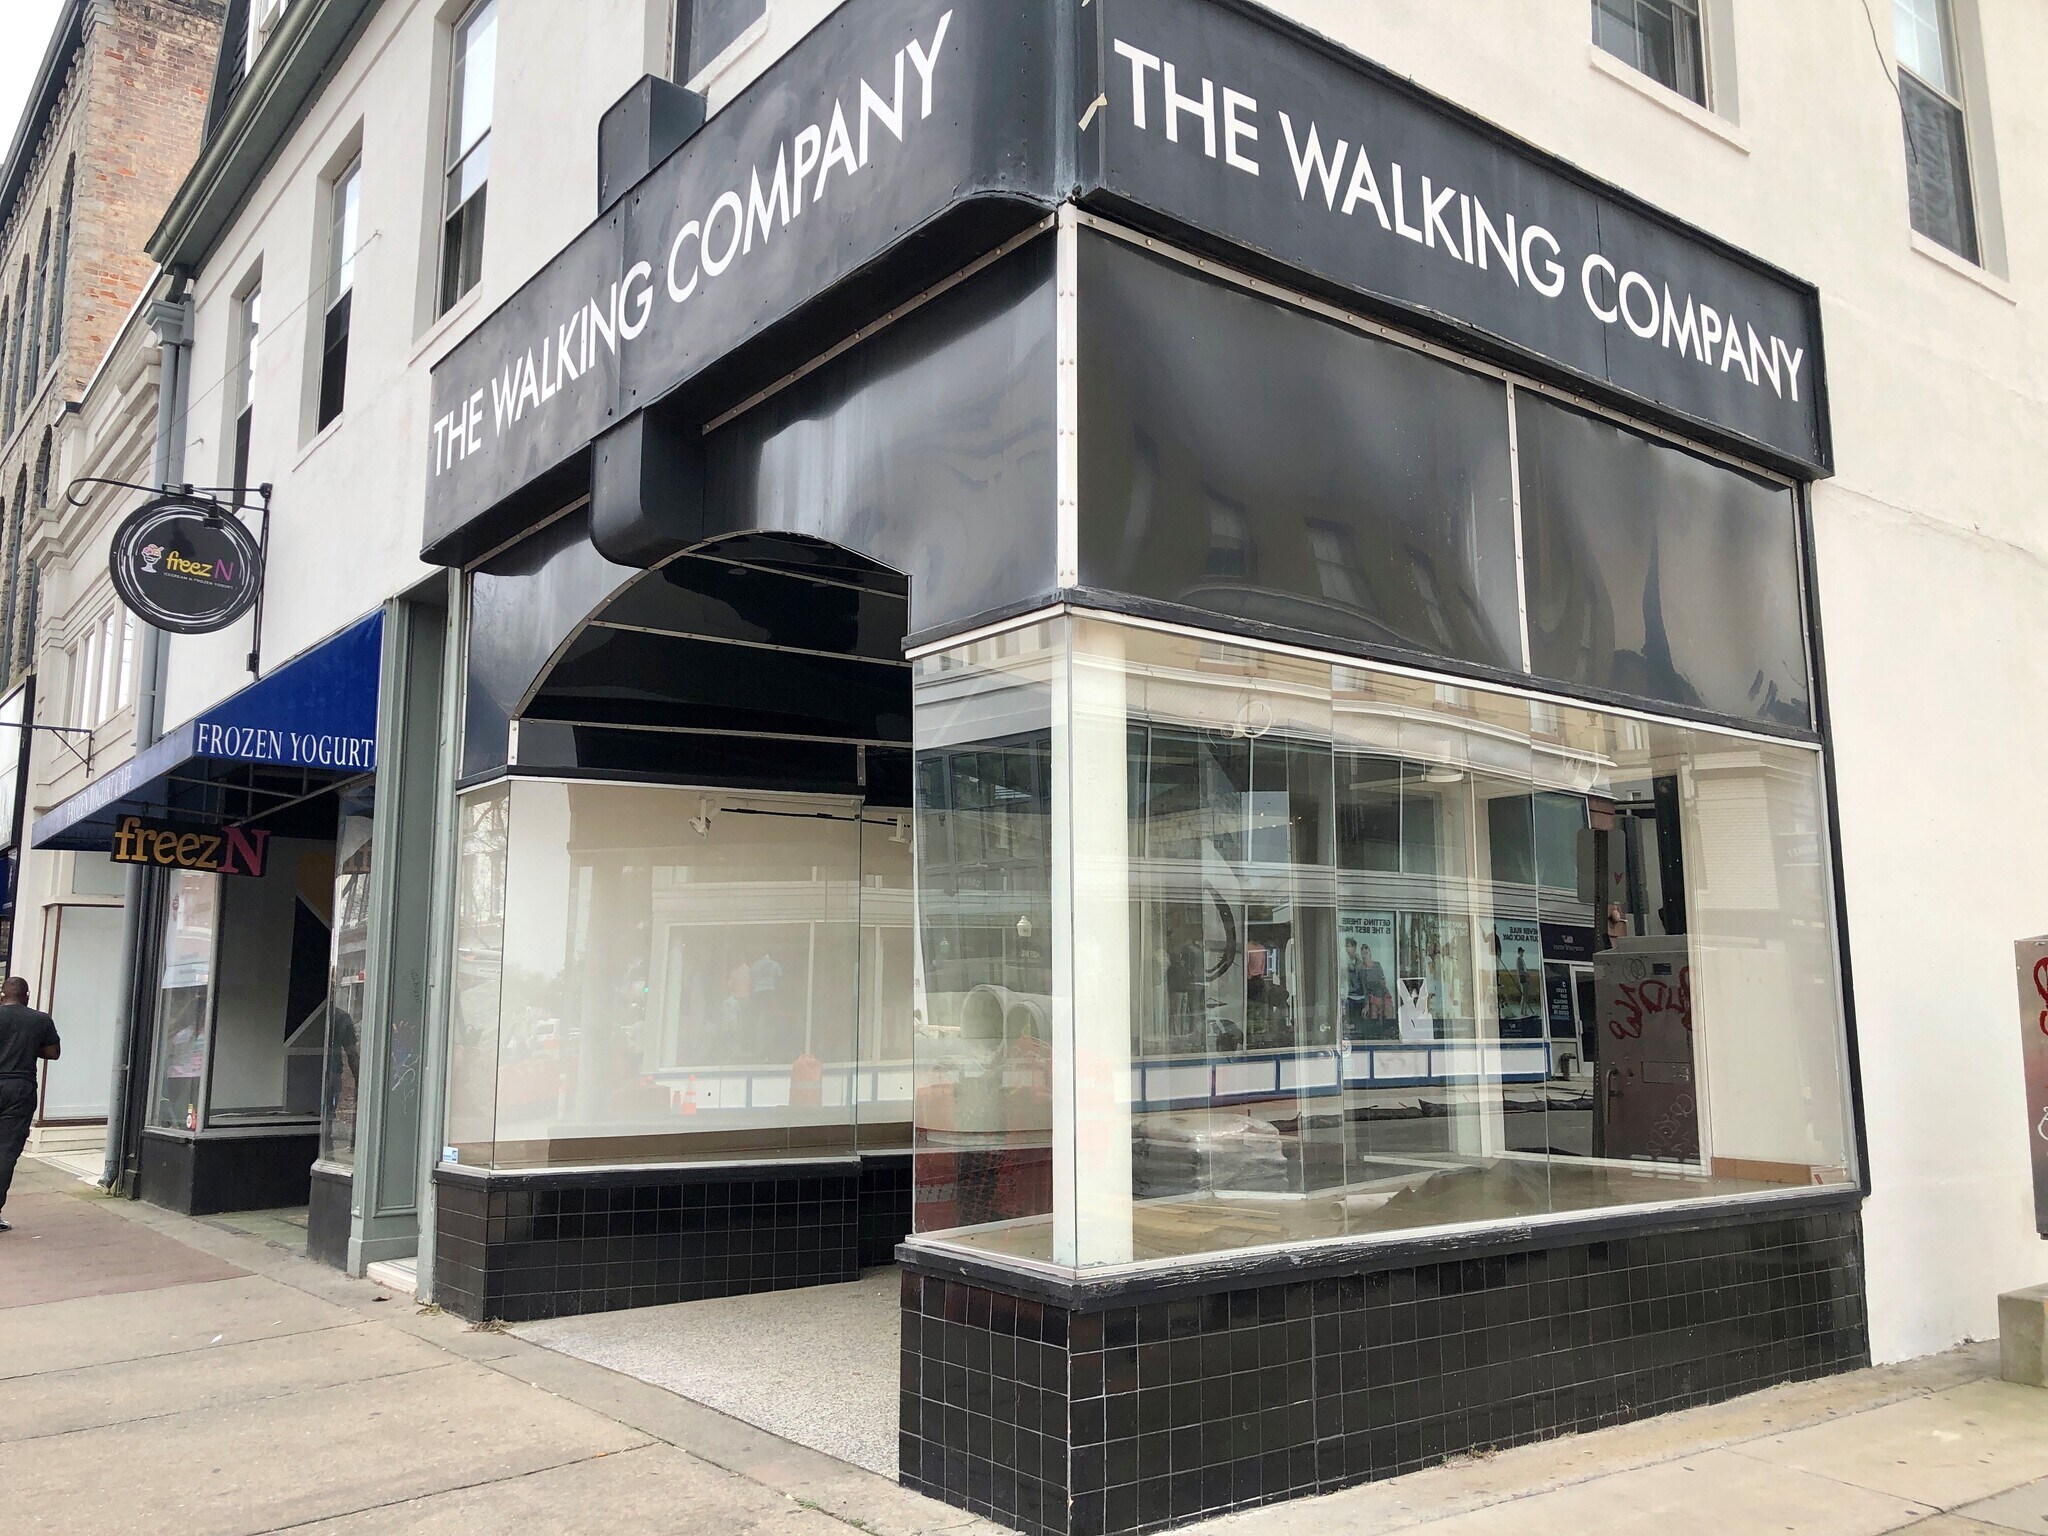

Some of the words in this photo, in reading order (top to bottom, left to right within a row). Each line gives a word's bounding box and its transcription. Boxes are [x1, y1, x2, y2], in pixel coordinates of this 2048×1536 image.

[434, 388, 483, 476] THE
[492, 260, 653, 437] WALKING
[667, 8, 954, 303] COMPANY
[1114, 39, 1259, 177] THE
[1279, 111, 1566, 298] WALKING
[1581, 254, 1804, 402] COMPANY
[114, 816, 271, 876] freezN
[197, 722, 284, 760] FROZEN
[290, 732, 374, 768] YOGURT
